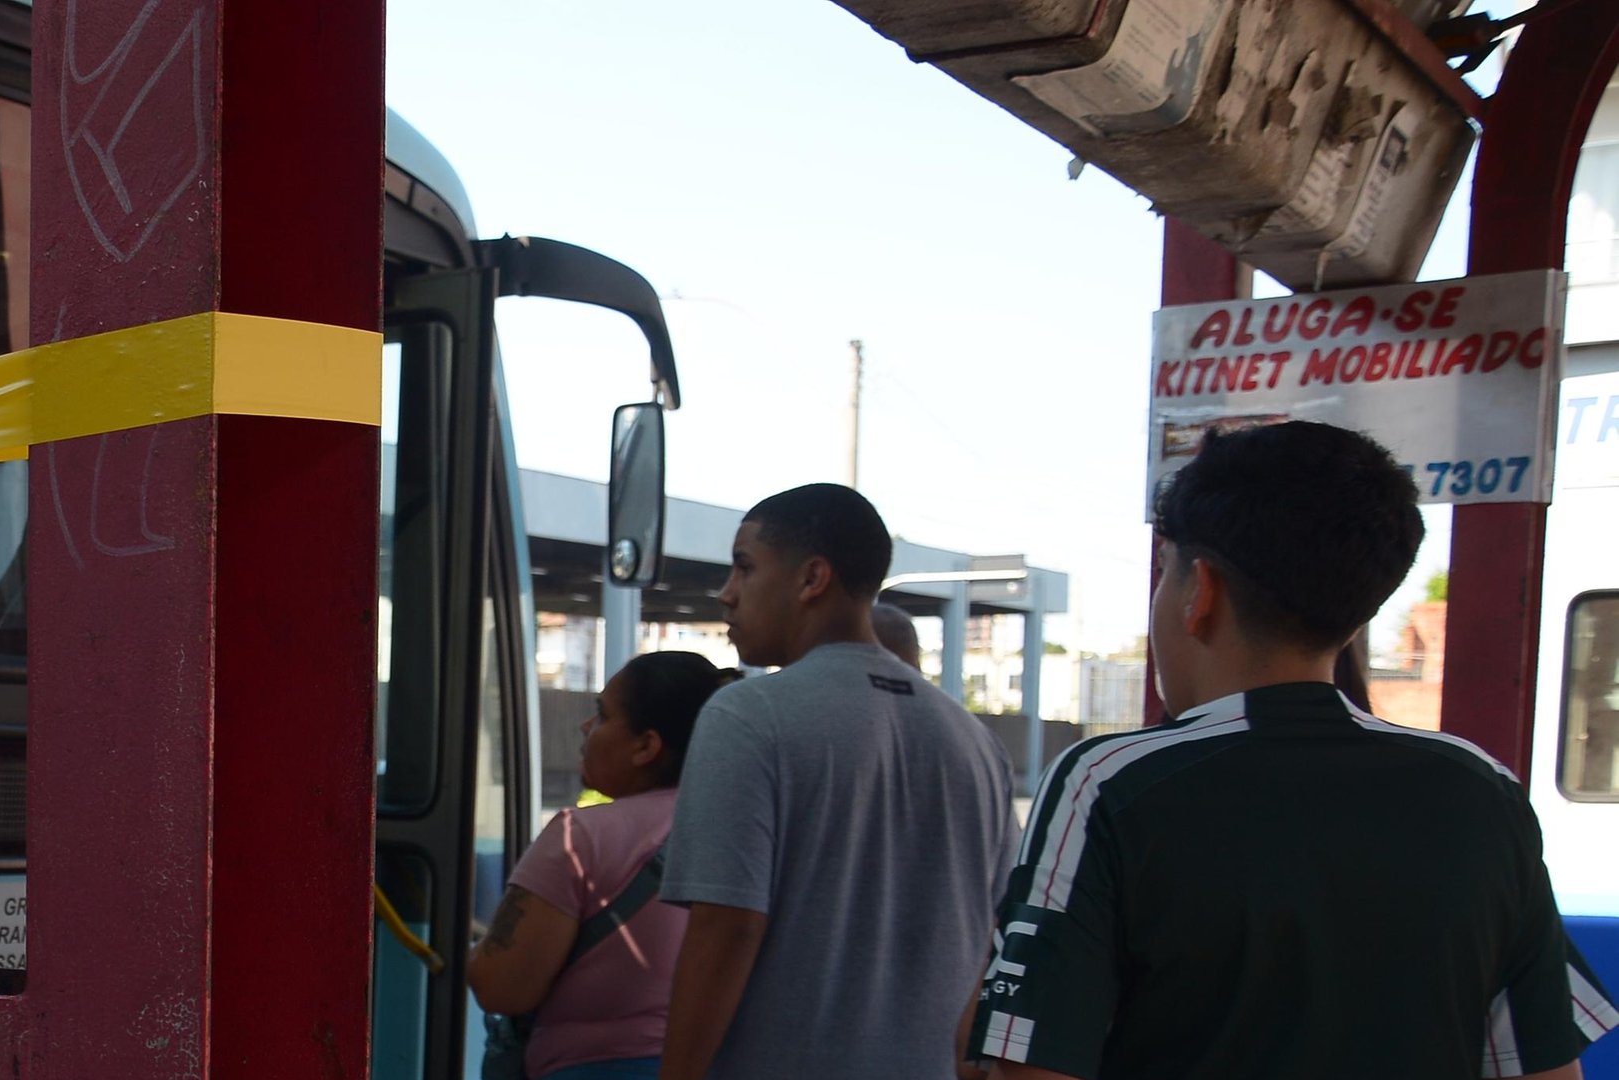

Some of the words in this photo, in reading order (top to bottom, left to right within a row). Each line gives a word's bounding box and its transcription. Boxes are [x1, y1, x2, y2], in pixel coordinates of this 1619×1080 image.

[1191, 286, 1468, 350] ALUGA-SE
[1155, 350, 1293, 398] KITNET
[1299, 327, 1551, 387] MOBILIADO
[1427, 456, 1532, 498] 7307
